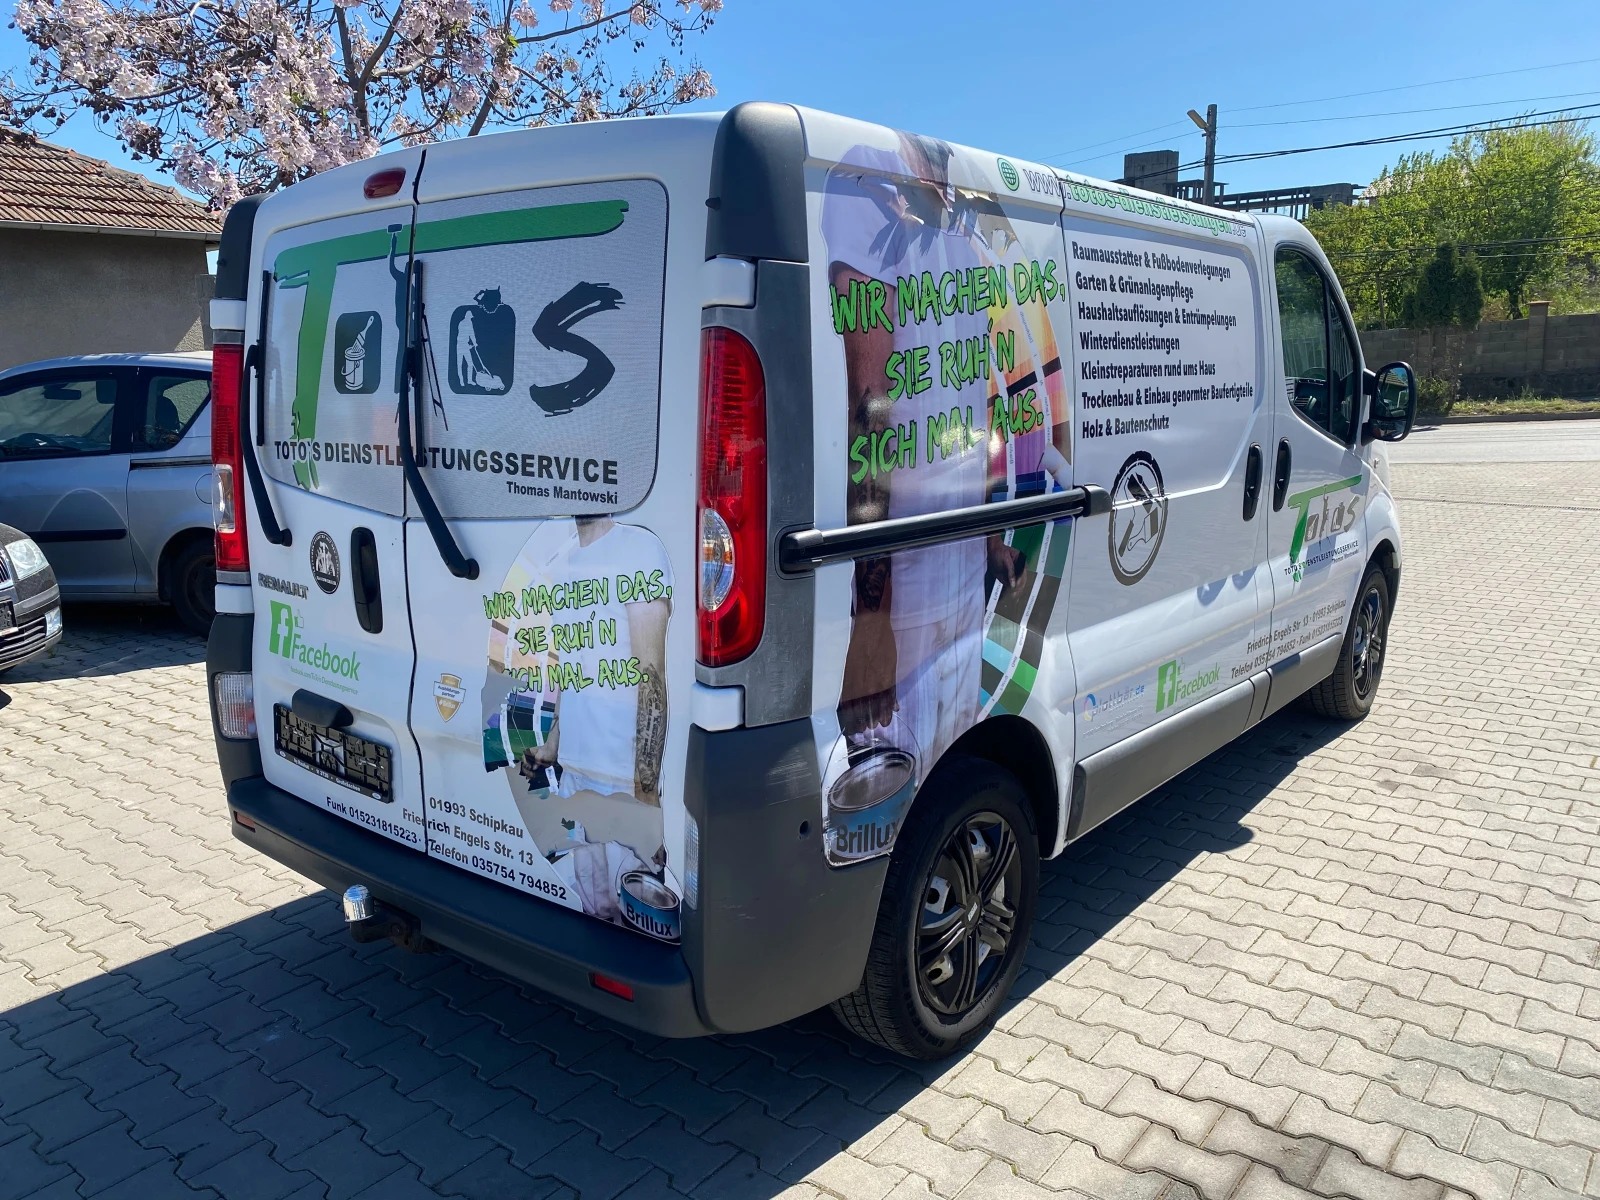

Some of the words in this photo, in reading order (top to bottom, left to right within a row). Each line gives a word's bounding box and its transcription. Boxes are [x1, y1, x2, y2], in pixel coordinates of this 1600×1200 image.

[1072, 241, 1142, 267] Raumausstatter
[1144, 251, 1151, 268] &
[1152, 252, 1231, 282] Fußbodenverlegungen
[829, 278, 894, 335] WIR
[897, 264, 1008, 327] MACHEN
[1013, 259, 1066, 306] DAS,
[1075, 271, 1108, 292] Garten
[1109, 274, 1117, 293] &
[1118, 275, 1194, 303] Grünanlagenpflege
[1078, 301, 1173, 328] Haushaltsauflösungen
[1174, 307, 1181, 324] &
[1182, 308, 1237, 331] Entrümpelungen
[1080, 330, 1180, 355] Winterdienstleistungen
[885, 346, 933, 401] SIE
[1081, 360, 1162, 383] Kleinstreparaturen
[1164, 360, 1181, 377] rund
[1183, 362, 1197, 376] ums
[1199, 360, 1216, 376] Haus
[1082, 389, 1134, 409] Trockenbau
[1135, 388, 1143, 405] &
[1144, 387, 1171, 405] Einbau
[1172, 386, 1210, 407] genormter
[1211, 382, 1253, 403] Baufertigteile
[850, 419, 917, 485] SICH
[927, 406, 985, 463] MAL
[991, 389, 1045, 444] AUS.
[1082, 419, 1103, 439] Holz
[1105, 418, 1113, 436] &
[1114, 414, 1170, 435] Bautenschutz
[506, 481, 550, 498] Thomas
[553, 486, 618, 504] Mantowski
[258, 573, 308, 600] RENAULT
[483, 591, 520, 619] WIR
[522, 577, 609, 616] MACHEN
[617, 569, 673, 603] DAS,
[515, 626, 548, 655] SIE
[1273, 625, 1292, 642] Engels
[1303, 615, 1309, 627] 13
[292, 633, 361, 681] Facebook
[547, 662, 594, 692] MAL
[598, 657, 649, 690] AUS.
[1175, 662, 1220, 702] Facebook
[429, 797, 466, 817] 01993
[469, 808, 524, 838] Schipkau
[326, 796, 347, 814] Funk
[427, 839, 469, 864] Telefon
[472, 855, 515, 881] 035754
[519, 872, 567, 900] 794852
[454, 825, 490, 851] Engels
[494, 842, 514, 859] Str.
[519, 851, 533, 866] 13
[836, 818, 900, 853] Brillux
[626, 902, 672, 937] Brillux
